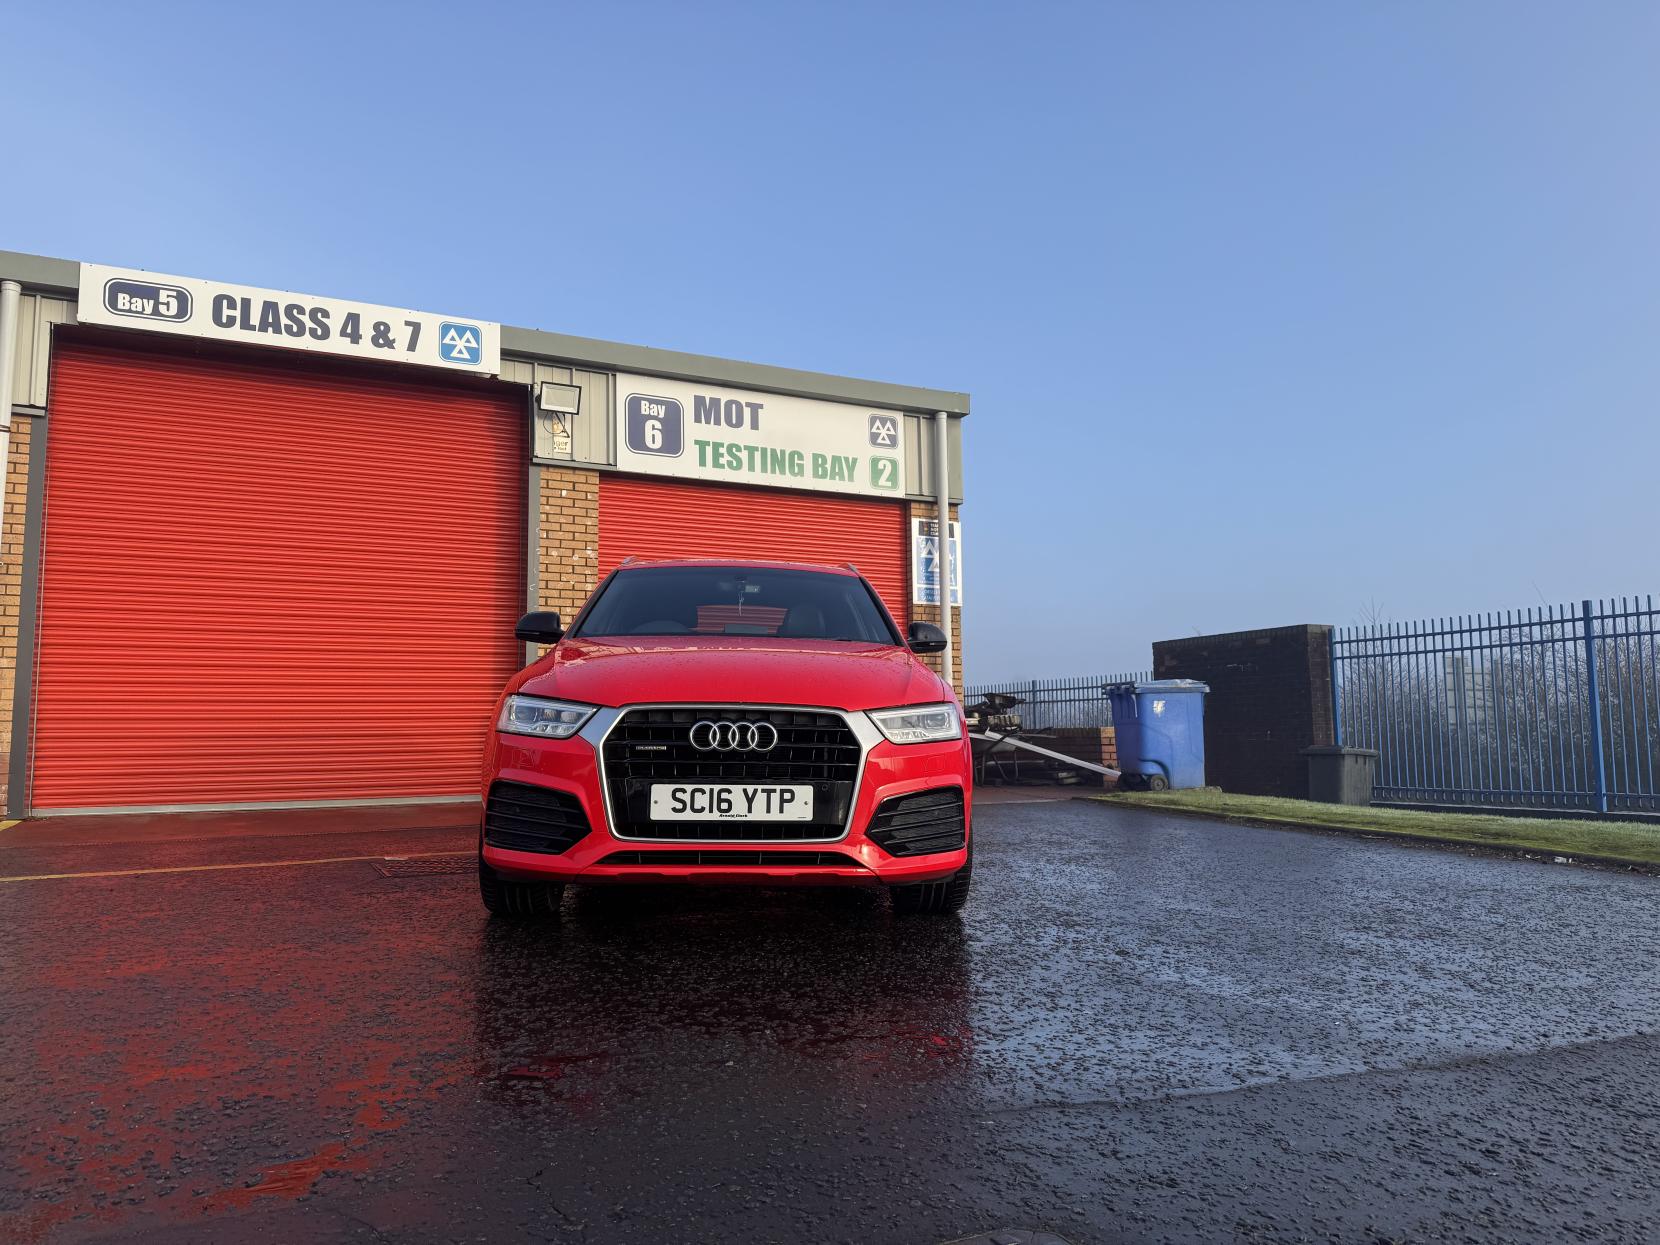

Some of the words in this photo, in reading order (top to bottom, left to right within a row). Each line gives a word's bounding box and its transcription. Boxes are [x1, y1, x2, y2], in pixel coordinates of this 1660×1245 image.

[117, 292, 155, 315] Bay
[158, 289, 178, 316] 5
[212, 293, 331, 341] CLASS
[340, 312, 362, 345] 4
[370, 320, 396, 350] &
[404, 320, 422, 353] 7
[640, 399, 666, 419] Bay
[693, 394, 764, 431] MOT
[644, 419, 663, 450] 6
[693, 439, 805, 478] TESTING
[811, 452, 859, 483] BAY
[877, 459, 893, 488] 2
[670, 787, 733, 814] SC16
[742, 787, 796, 814] YTP
